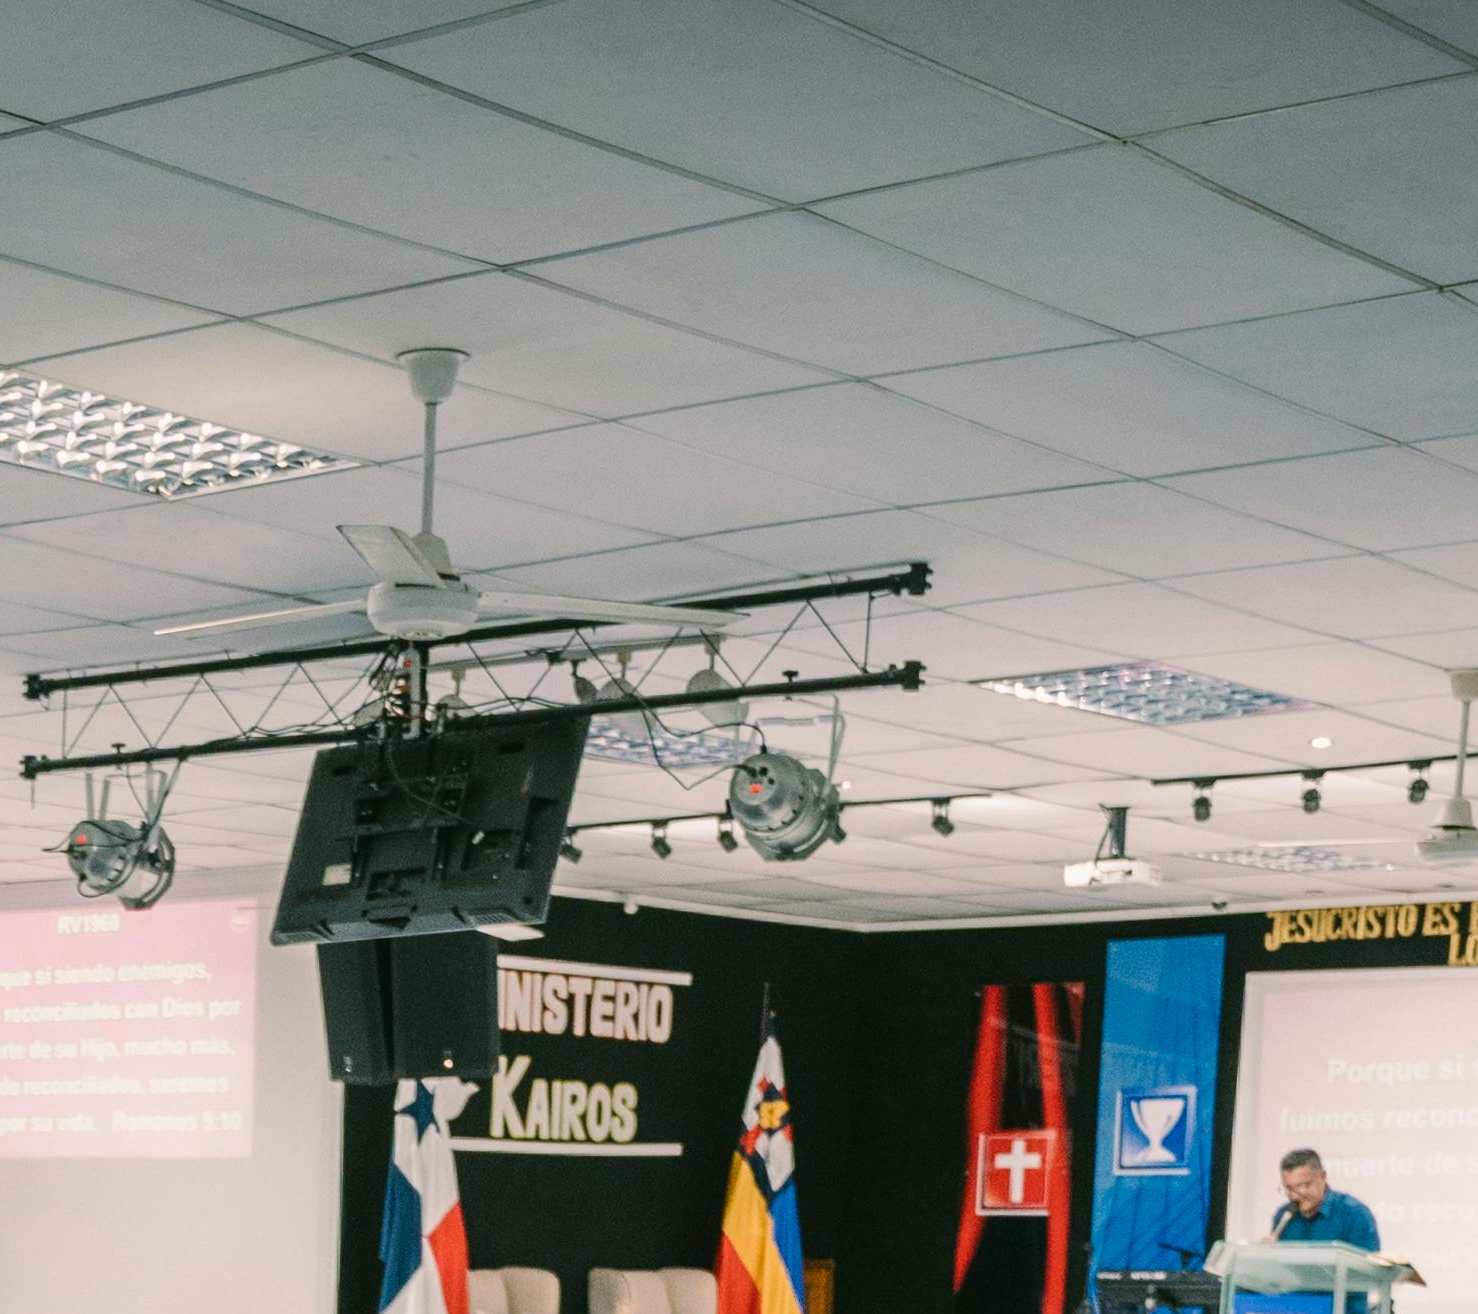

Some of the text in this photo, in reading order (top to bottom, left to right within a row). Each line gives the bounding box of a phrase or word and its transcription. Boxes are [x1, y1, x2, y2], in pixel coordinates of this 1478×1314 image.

[1264, 904, 1419, 951] JESUCRISTO
[1422, 902, 1461, 936] ES
[497, 968, 674, 1044] INISTERIO
[1327, 1058, 1430, 1089] Porque
[1278, 1105, 1376, 1132] fuimos
